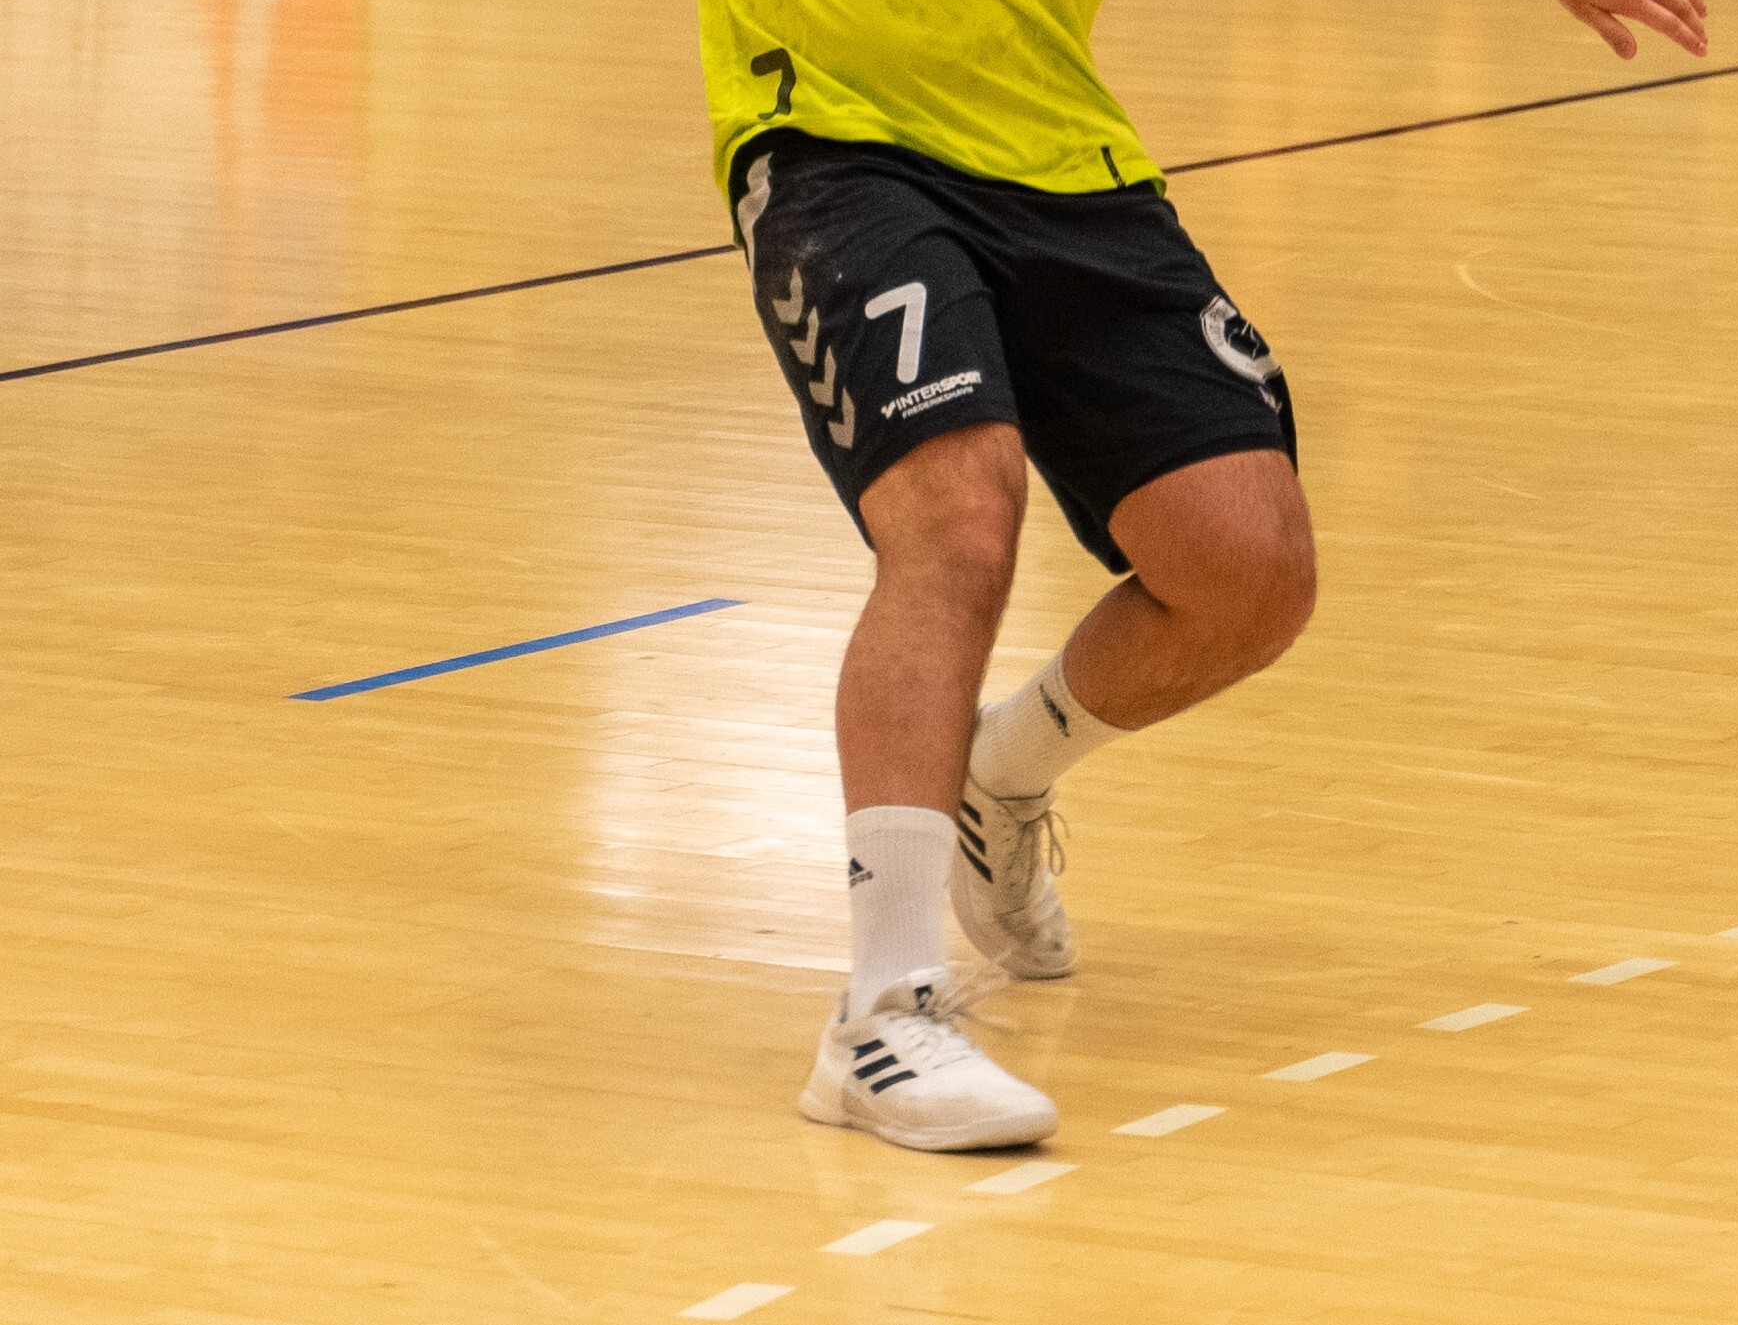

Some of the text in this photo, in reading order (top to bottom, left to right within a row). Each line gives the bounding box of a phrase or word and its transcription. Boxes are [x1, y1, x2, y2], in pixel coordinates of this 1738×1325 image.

[750, 47, 797, 121] 7
[864, 281, 928, 384] 7
[895, 370, 982, 412] INTERSPORT
